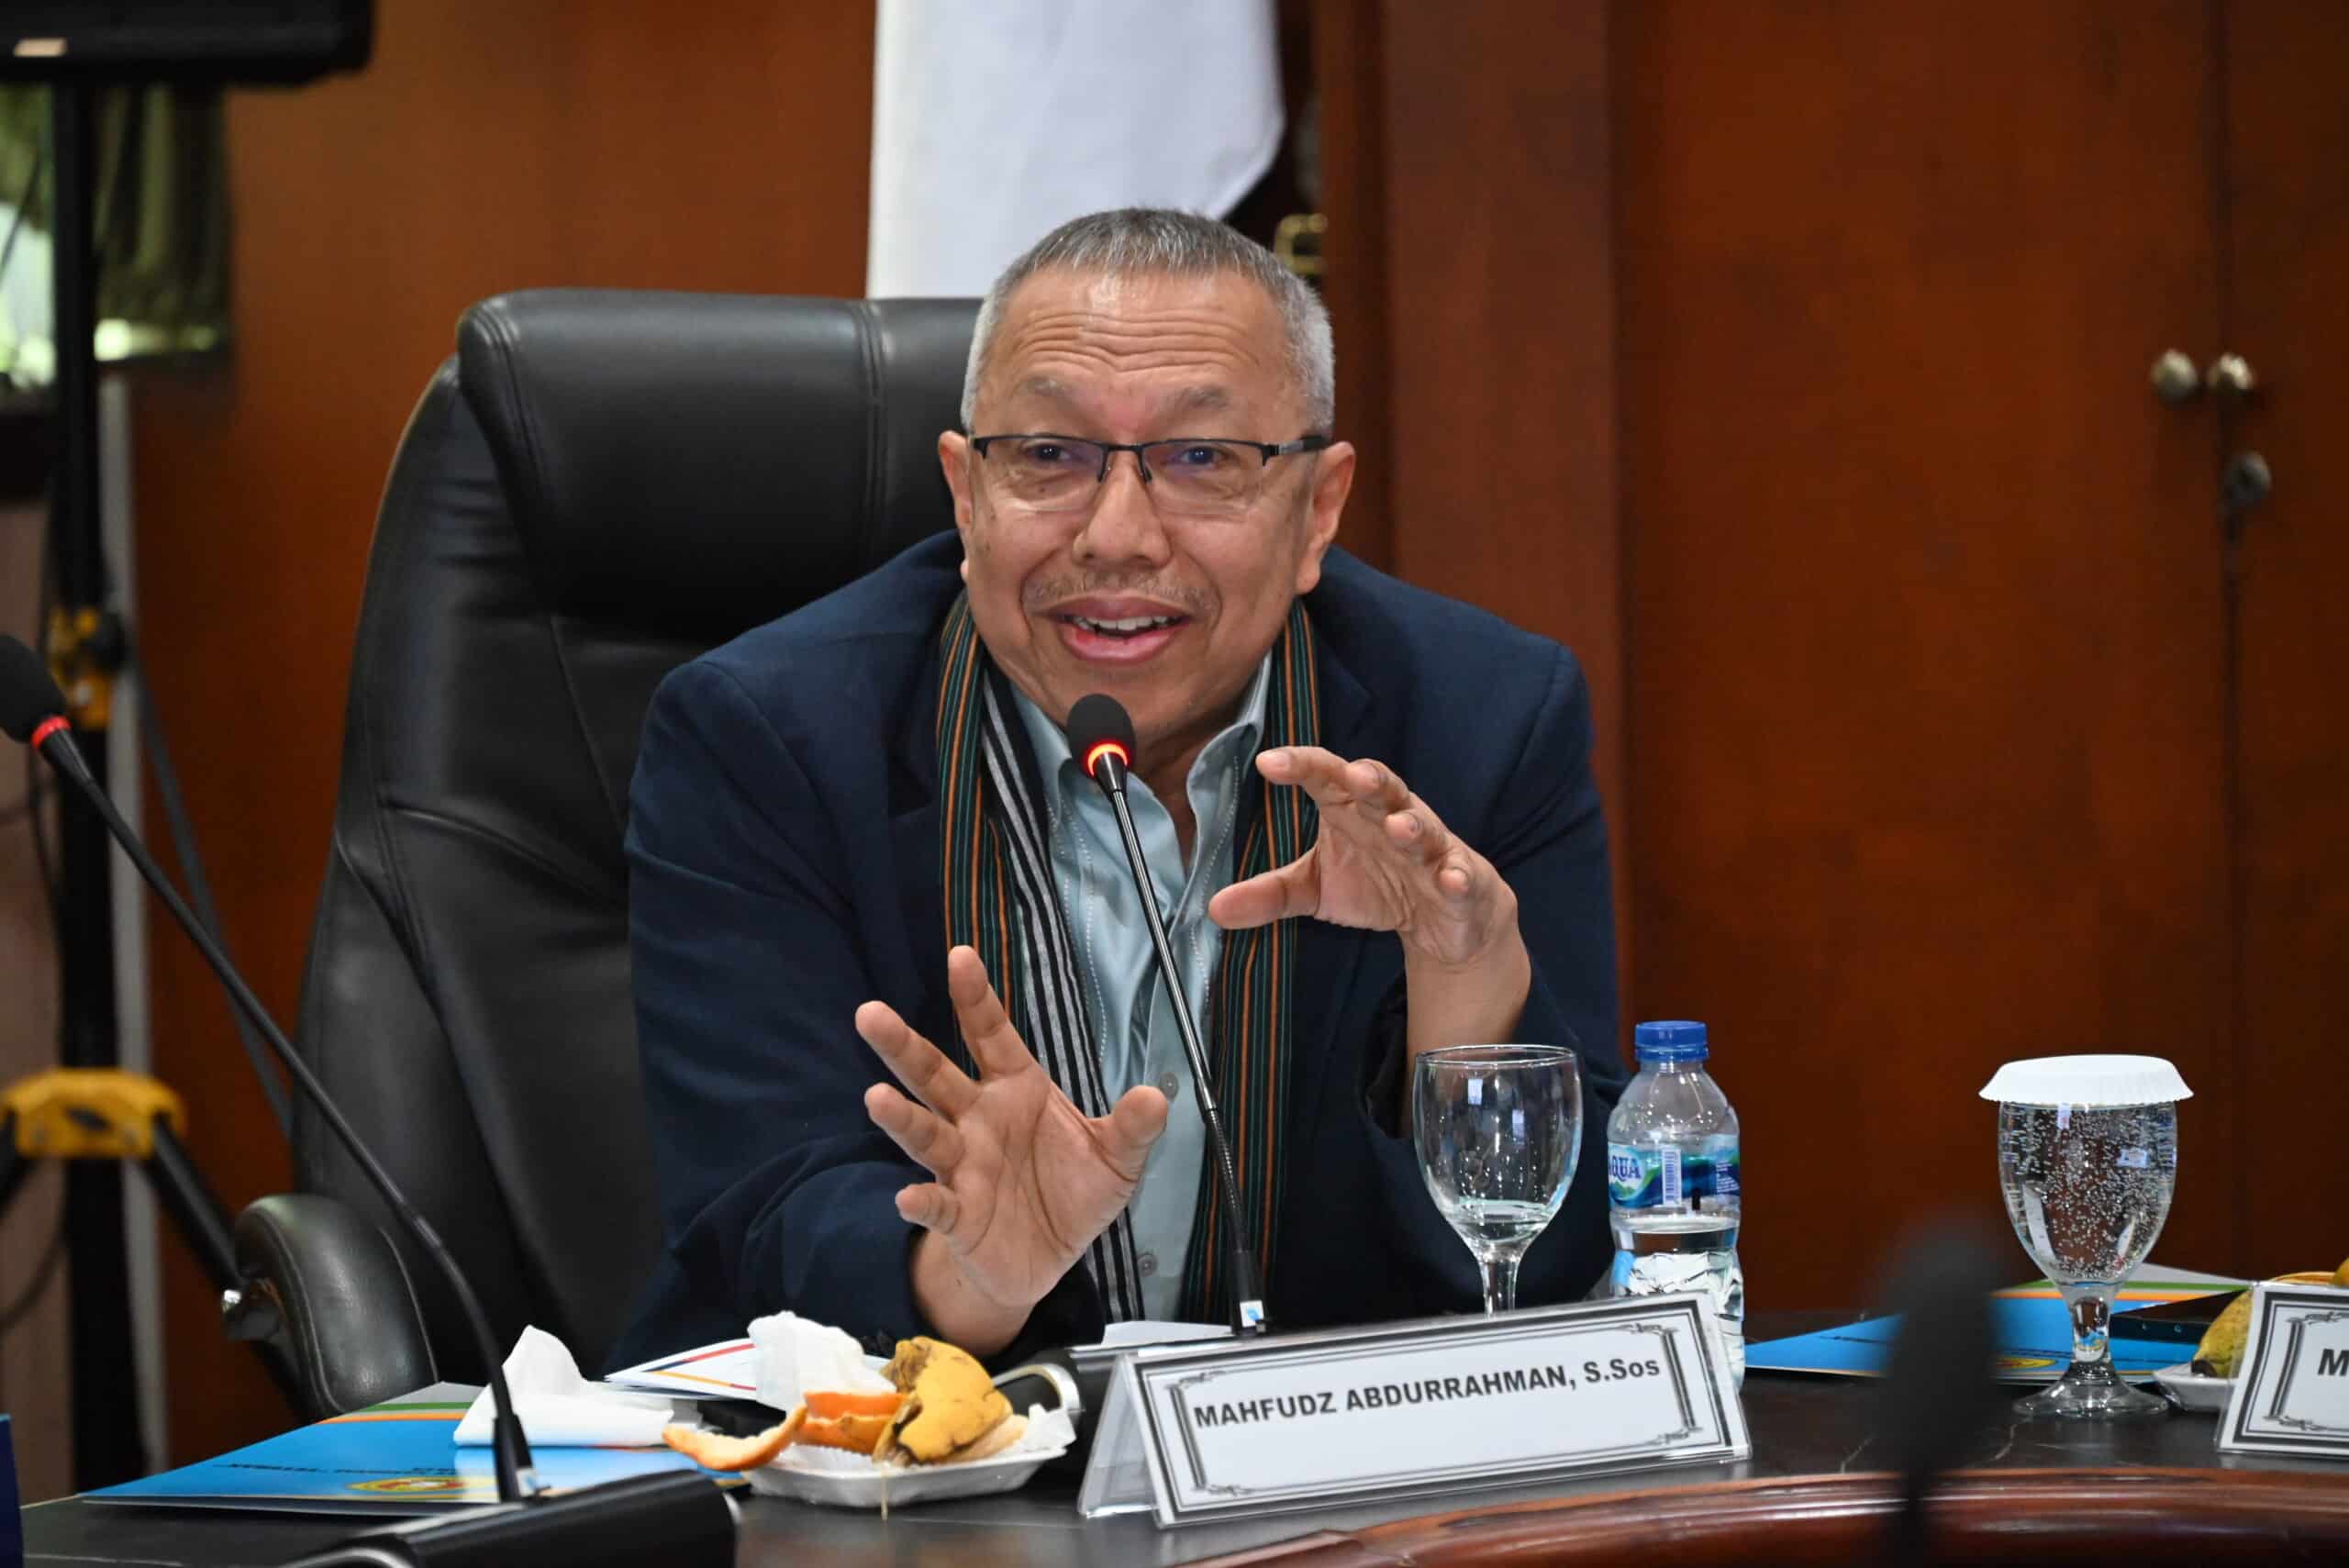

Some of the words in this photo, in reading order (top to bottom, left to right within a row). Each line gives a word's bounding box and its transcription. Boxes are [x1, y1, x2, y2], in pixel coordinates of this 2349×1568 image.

[1194, 1391, 1338, 1428] MAHFUDZ
[1346, 1364, 1577, 1411] ABDURRAHMAN,
[1584, 1358, 1661, 1384] S.Sos
